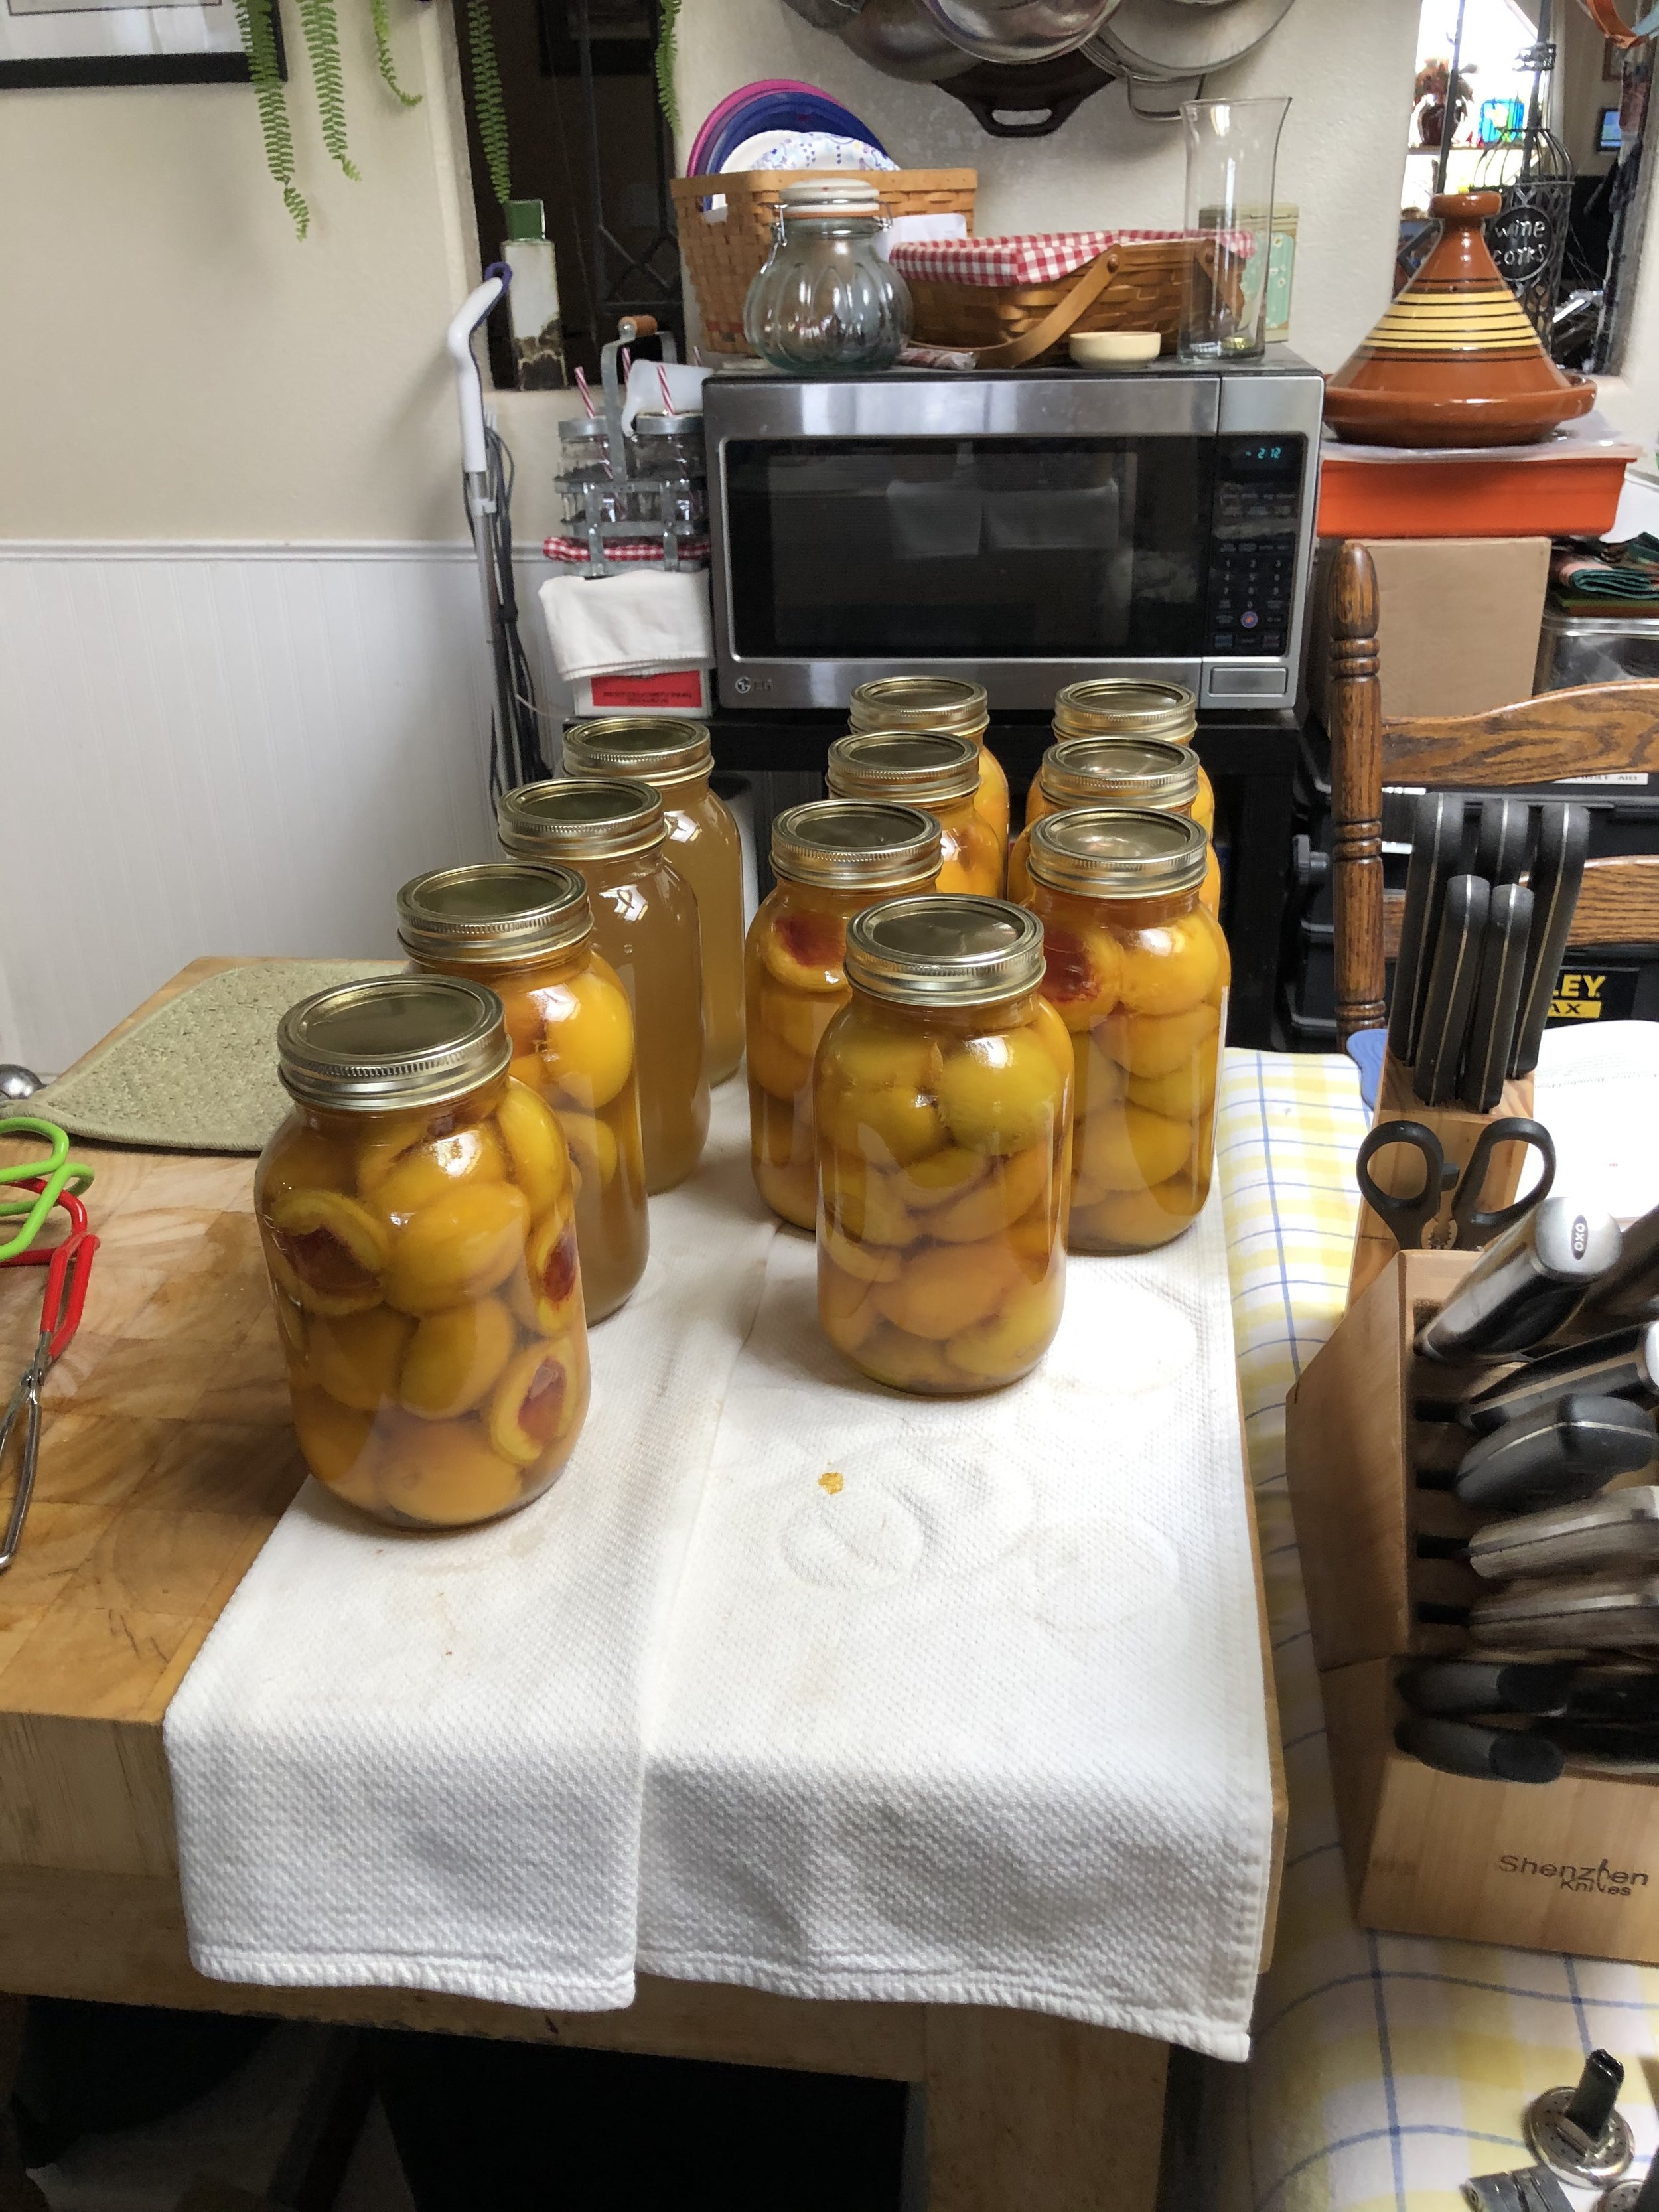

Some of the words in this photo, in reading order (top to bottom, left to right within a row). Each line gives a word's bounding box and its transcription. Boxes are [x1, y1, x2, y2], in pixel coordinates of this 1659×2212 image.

[1494, 219, 1546, 238] wine
[1553, 974, 1606, 998] EY
[1574, 1222, 1585, 1252] OXO
[1498, 1854, 1649, 1887] Shenzhen
